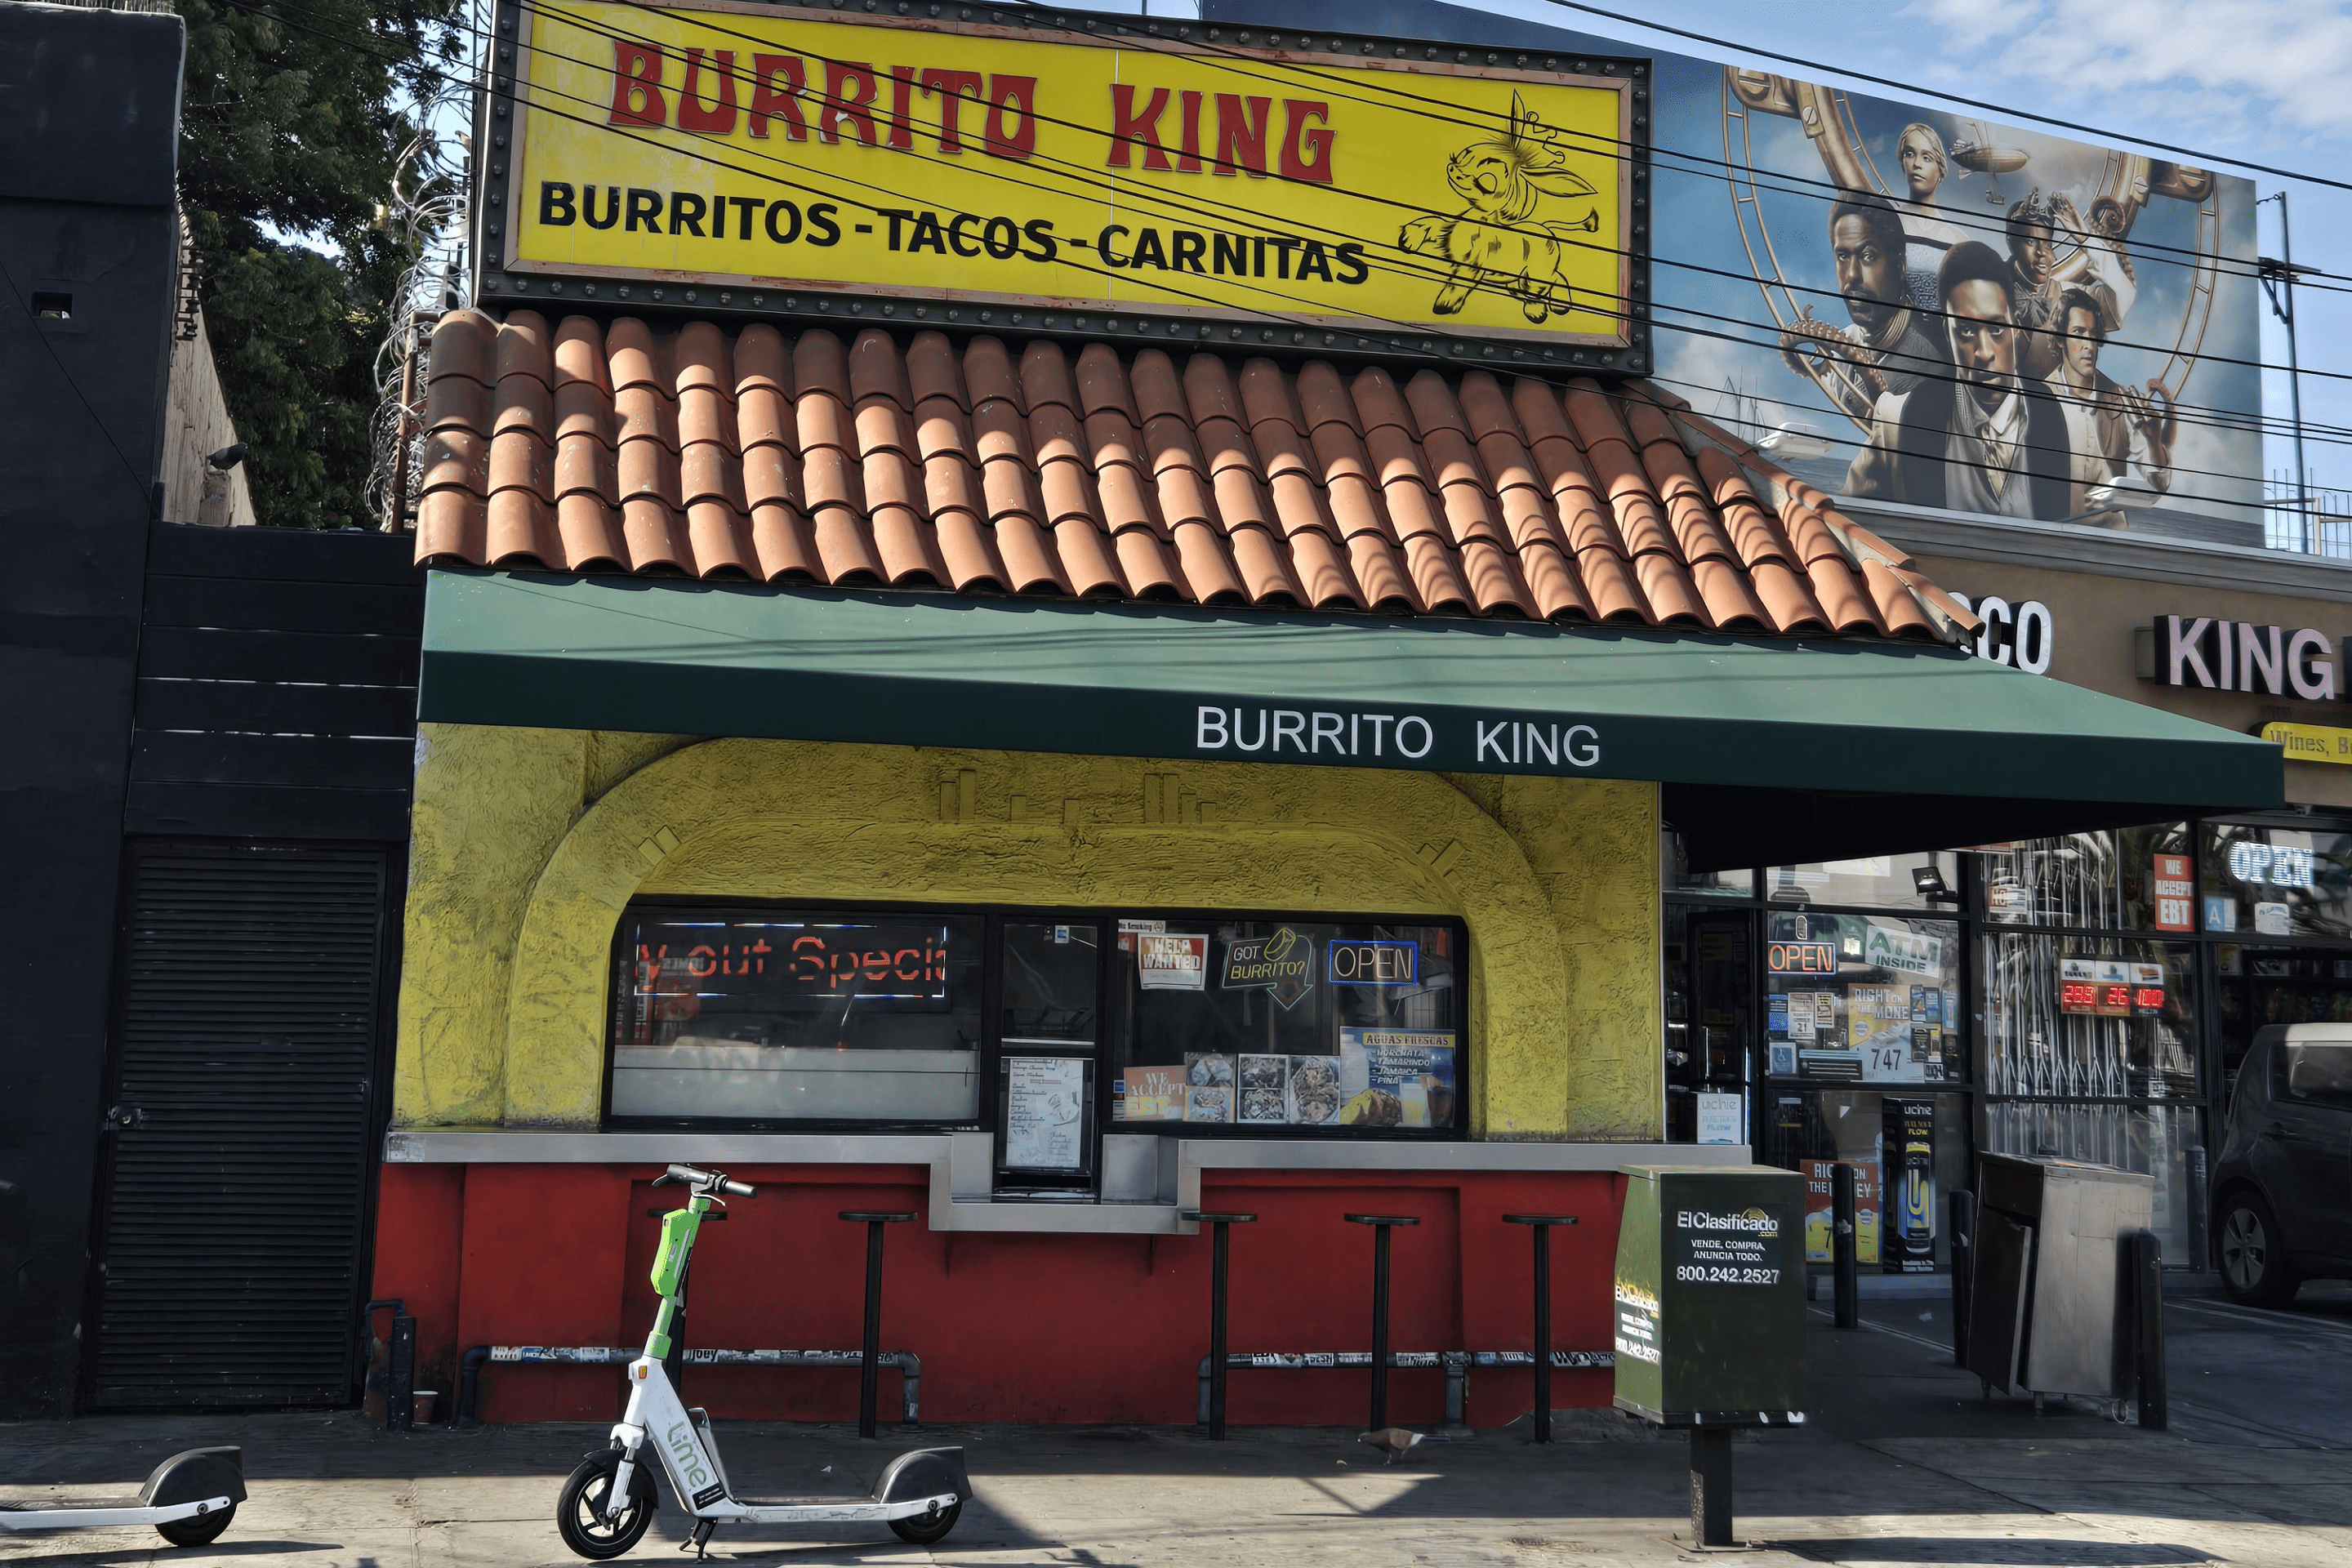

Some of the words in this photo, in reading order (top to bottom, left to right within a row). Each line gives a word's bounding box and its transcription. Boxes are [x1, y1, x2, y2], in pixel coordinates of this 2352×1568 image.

[608, 39, 1038, 160] BURRITO
[1106, 83, 1337, 185] KING
[1196, 706, 1433, 759] BURRITO
[1476, 720, 1600, 768] KING
[2270, 729, 2330, 757] Wines,
[2165, 859, 2182, 875] WE
[2230, 841, 2313, 888] OPEN
[2154, 880, 2192, 897] ACCEPT
[2160, 899, 2190, 925] EBT
[1154, 938, 1192, 953] HELP
[1233, 946, 1261, 961] GOT
[1869, 931, 1939, 963] ATM
[1143, 955, 1200, 969] WANTED
[1334, 947, 1412, 979] OPEN
[1768, 944, 1833, 972] OPEN
[1876, 955, 1927, 973] INSIDE
[1231, 960, 1306, 980] BURRITO?
[1854, 988, 1891, 1003] RIGHT
[1366, 1034, 1402, 1045] AGUAS
[1404, 1034, 1449, 1046] FRESCAS
[1871, 1048, 1901, 1071] 747
[1146, 1071, 1169, 1085] WE
[1130, 1083, 1184, 1096] ACCEPT
[1908, 1128, 1928, 1136] FLOW
[1808, 1181, 1827, 1193] THE
[1694, 1250, 1735, 1260] ANUNCIA
[1676, 1265, 1780, 1284] 800.242.2527
[666, 1421, 707, 1487] Lime
